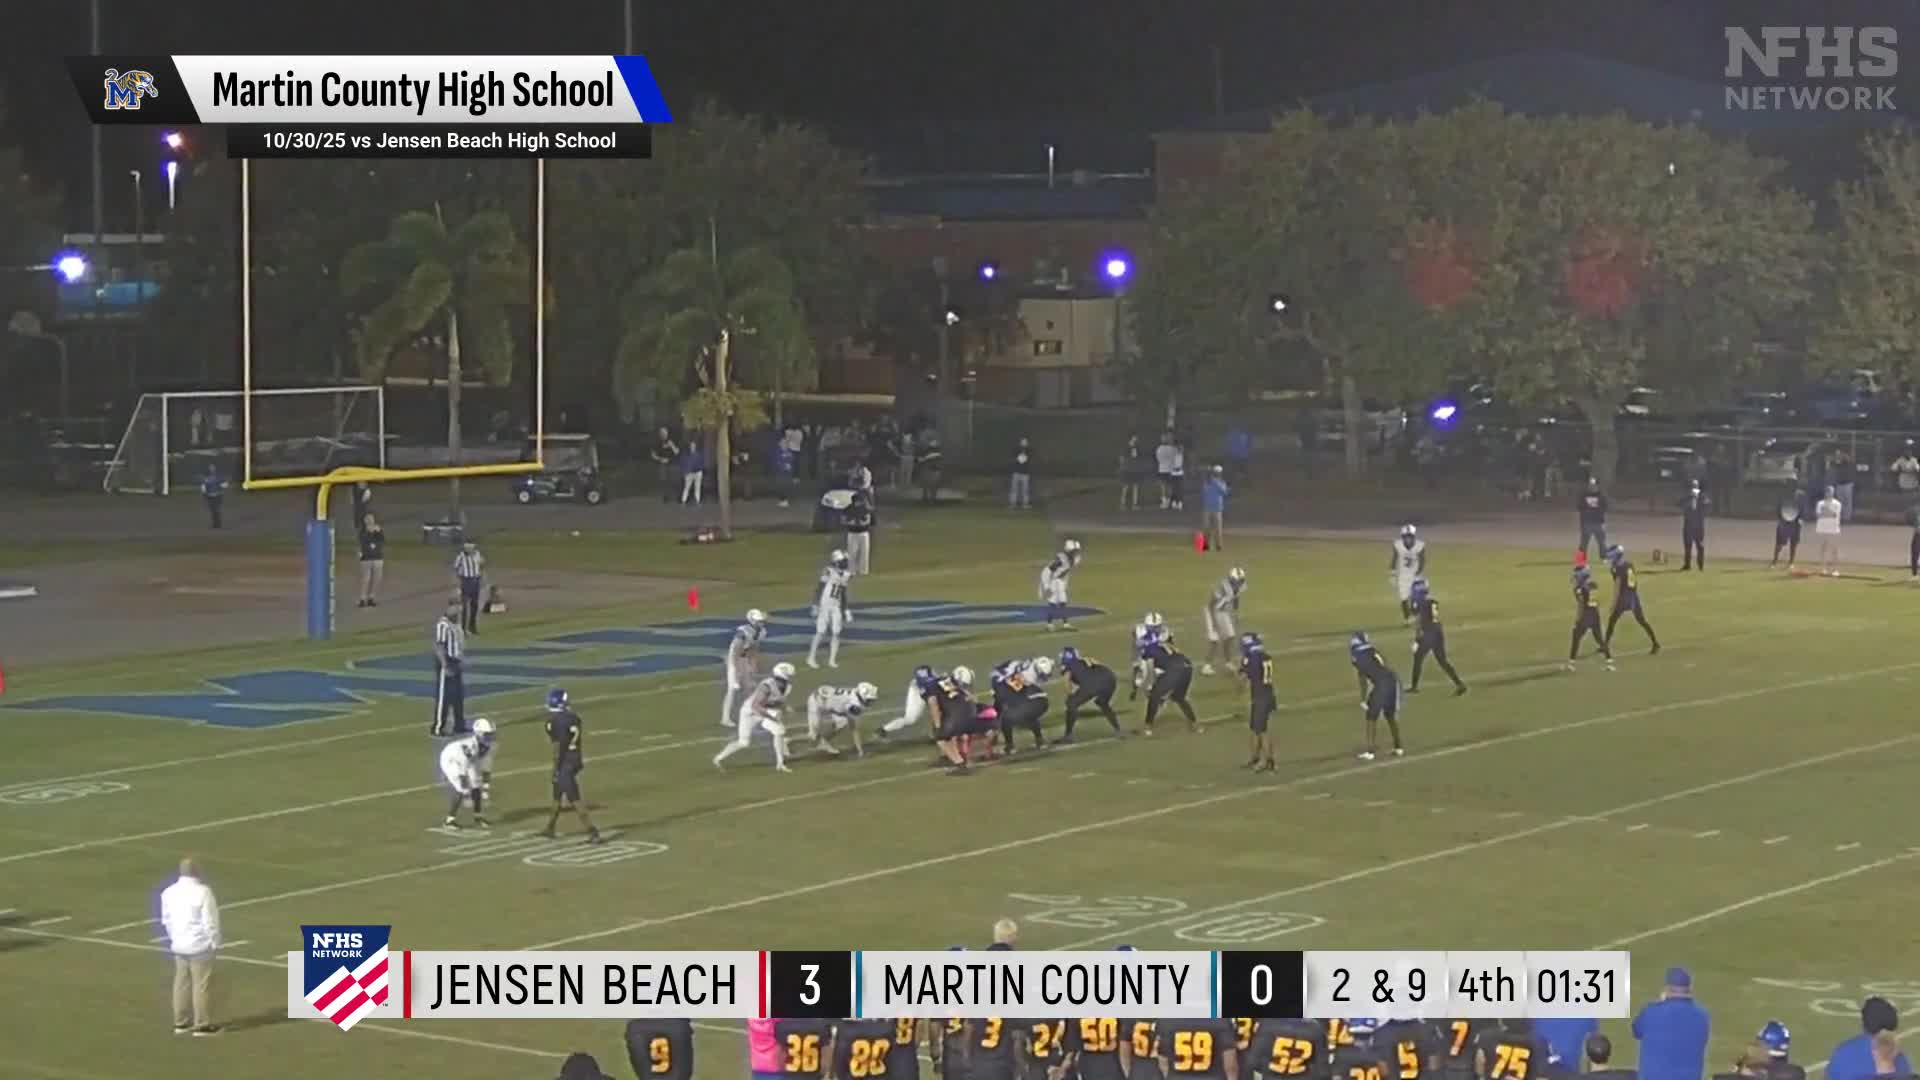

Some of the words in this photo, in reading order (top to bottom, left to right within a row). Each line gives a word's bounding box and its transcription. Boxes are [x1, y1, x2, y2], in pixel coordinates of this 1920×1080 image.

[981, 1018, 1002, 1048] 3
[1079, 1018, 1118, 1052] 50
[1173, 1031, 1213, 1072] 59
[1451, 1021, 1470, 1056] 7
[648, 1036, 669, 1073] 9
[785, 1034, 821, 1073] 36
[1268, 1036, 1313, 1075] 52
[1397, 1040, 1419, 1079] 5
[1490, 1044, 1530, 1080] 75
